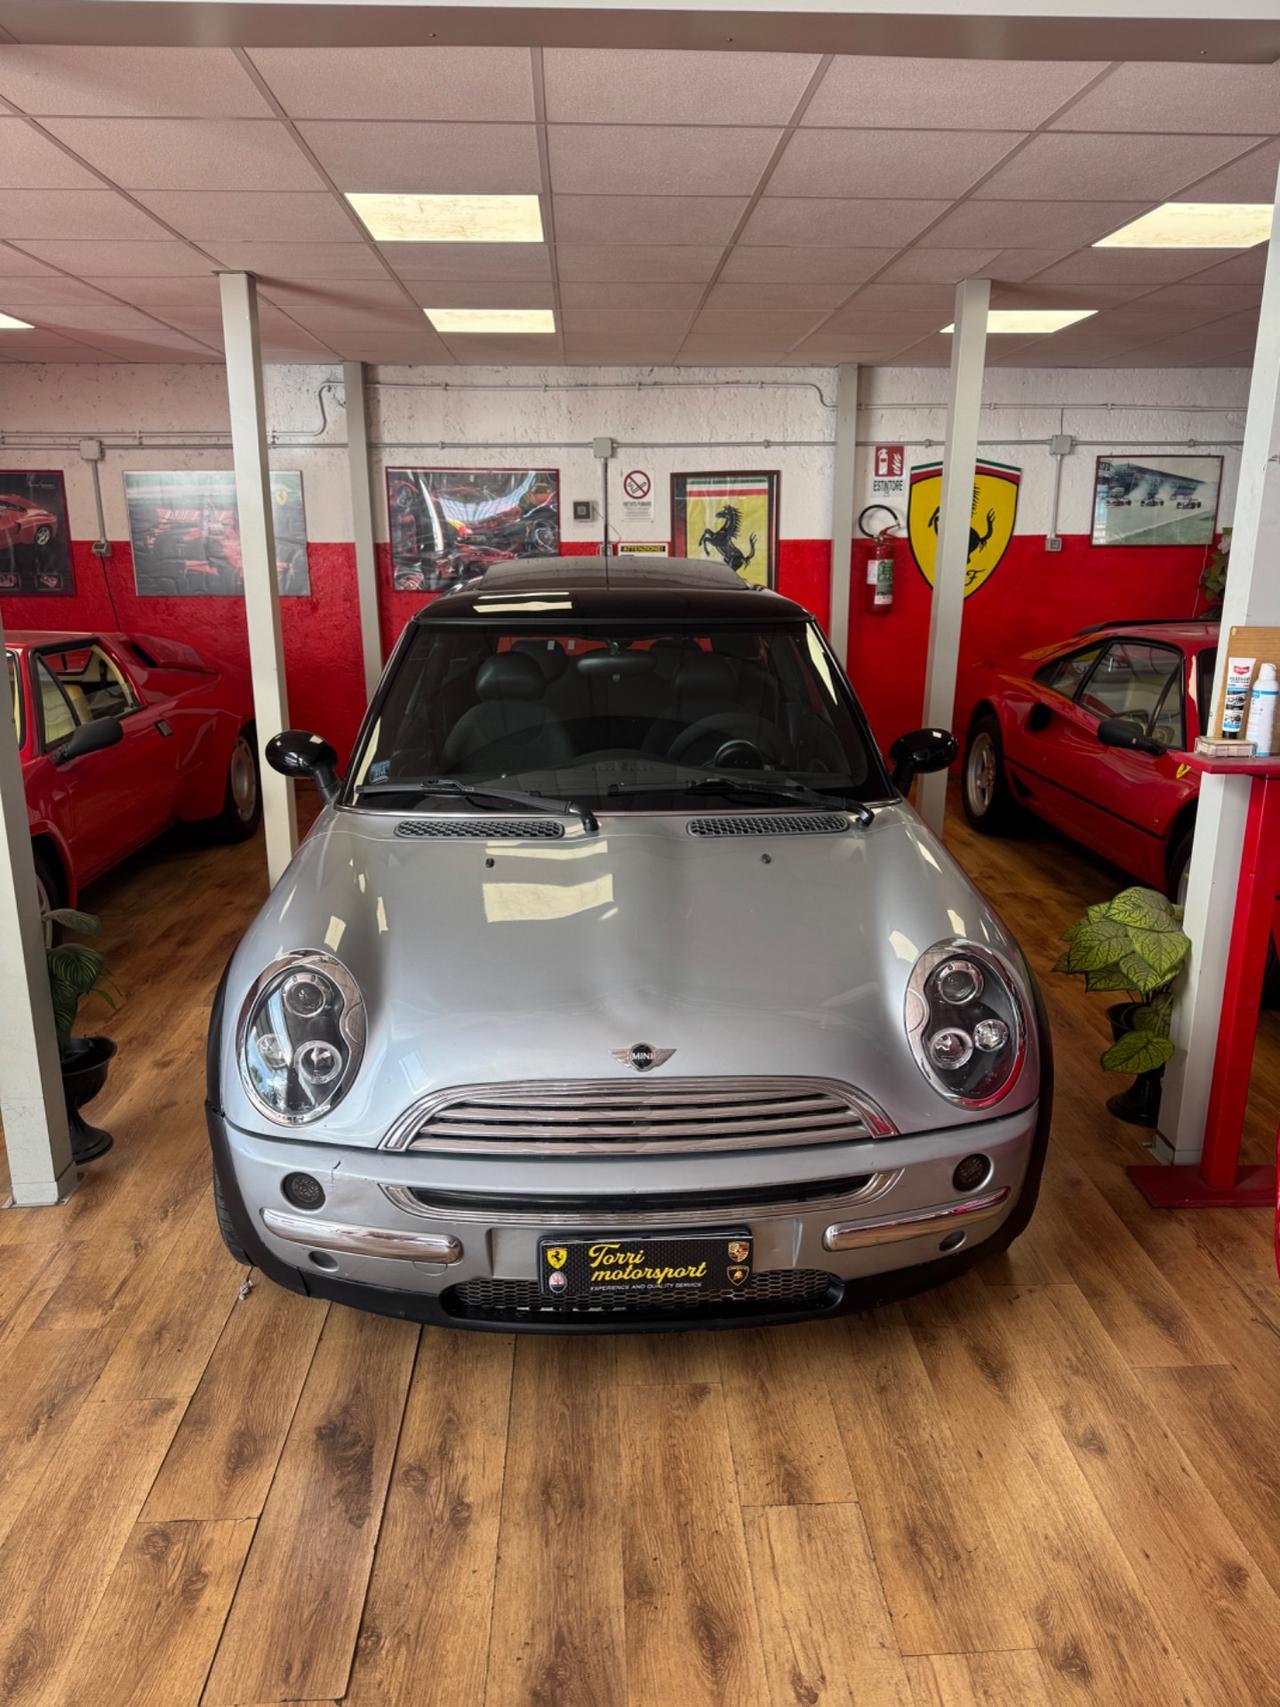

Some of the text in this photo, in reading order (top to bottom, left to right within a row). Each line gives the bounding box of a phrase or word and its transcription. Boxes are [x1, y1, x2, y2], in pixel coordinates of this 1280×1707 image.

[873, 480, 904, 492] ESTINTORE
[632, 1052, 653, 1060] MINI
[588, 1243, 645, 1267] Torri
[590, 1262, 706, 1284] motorsport
